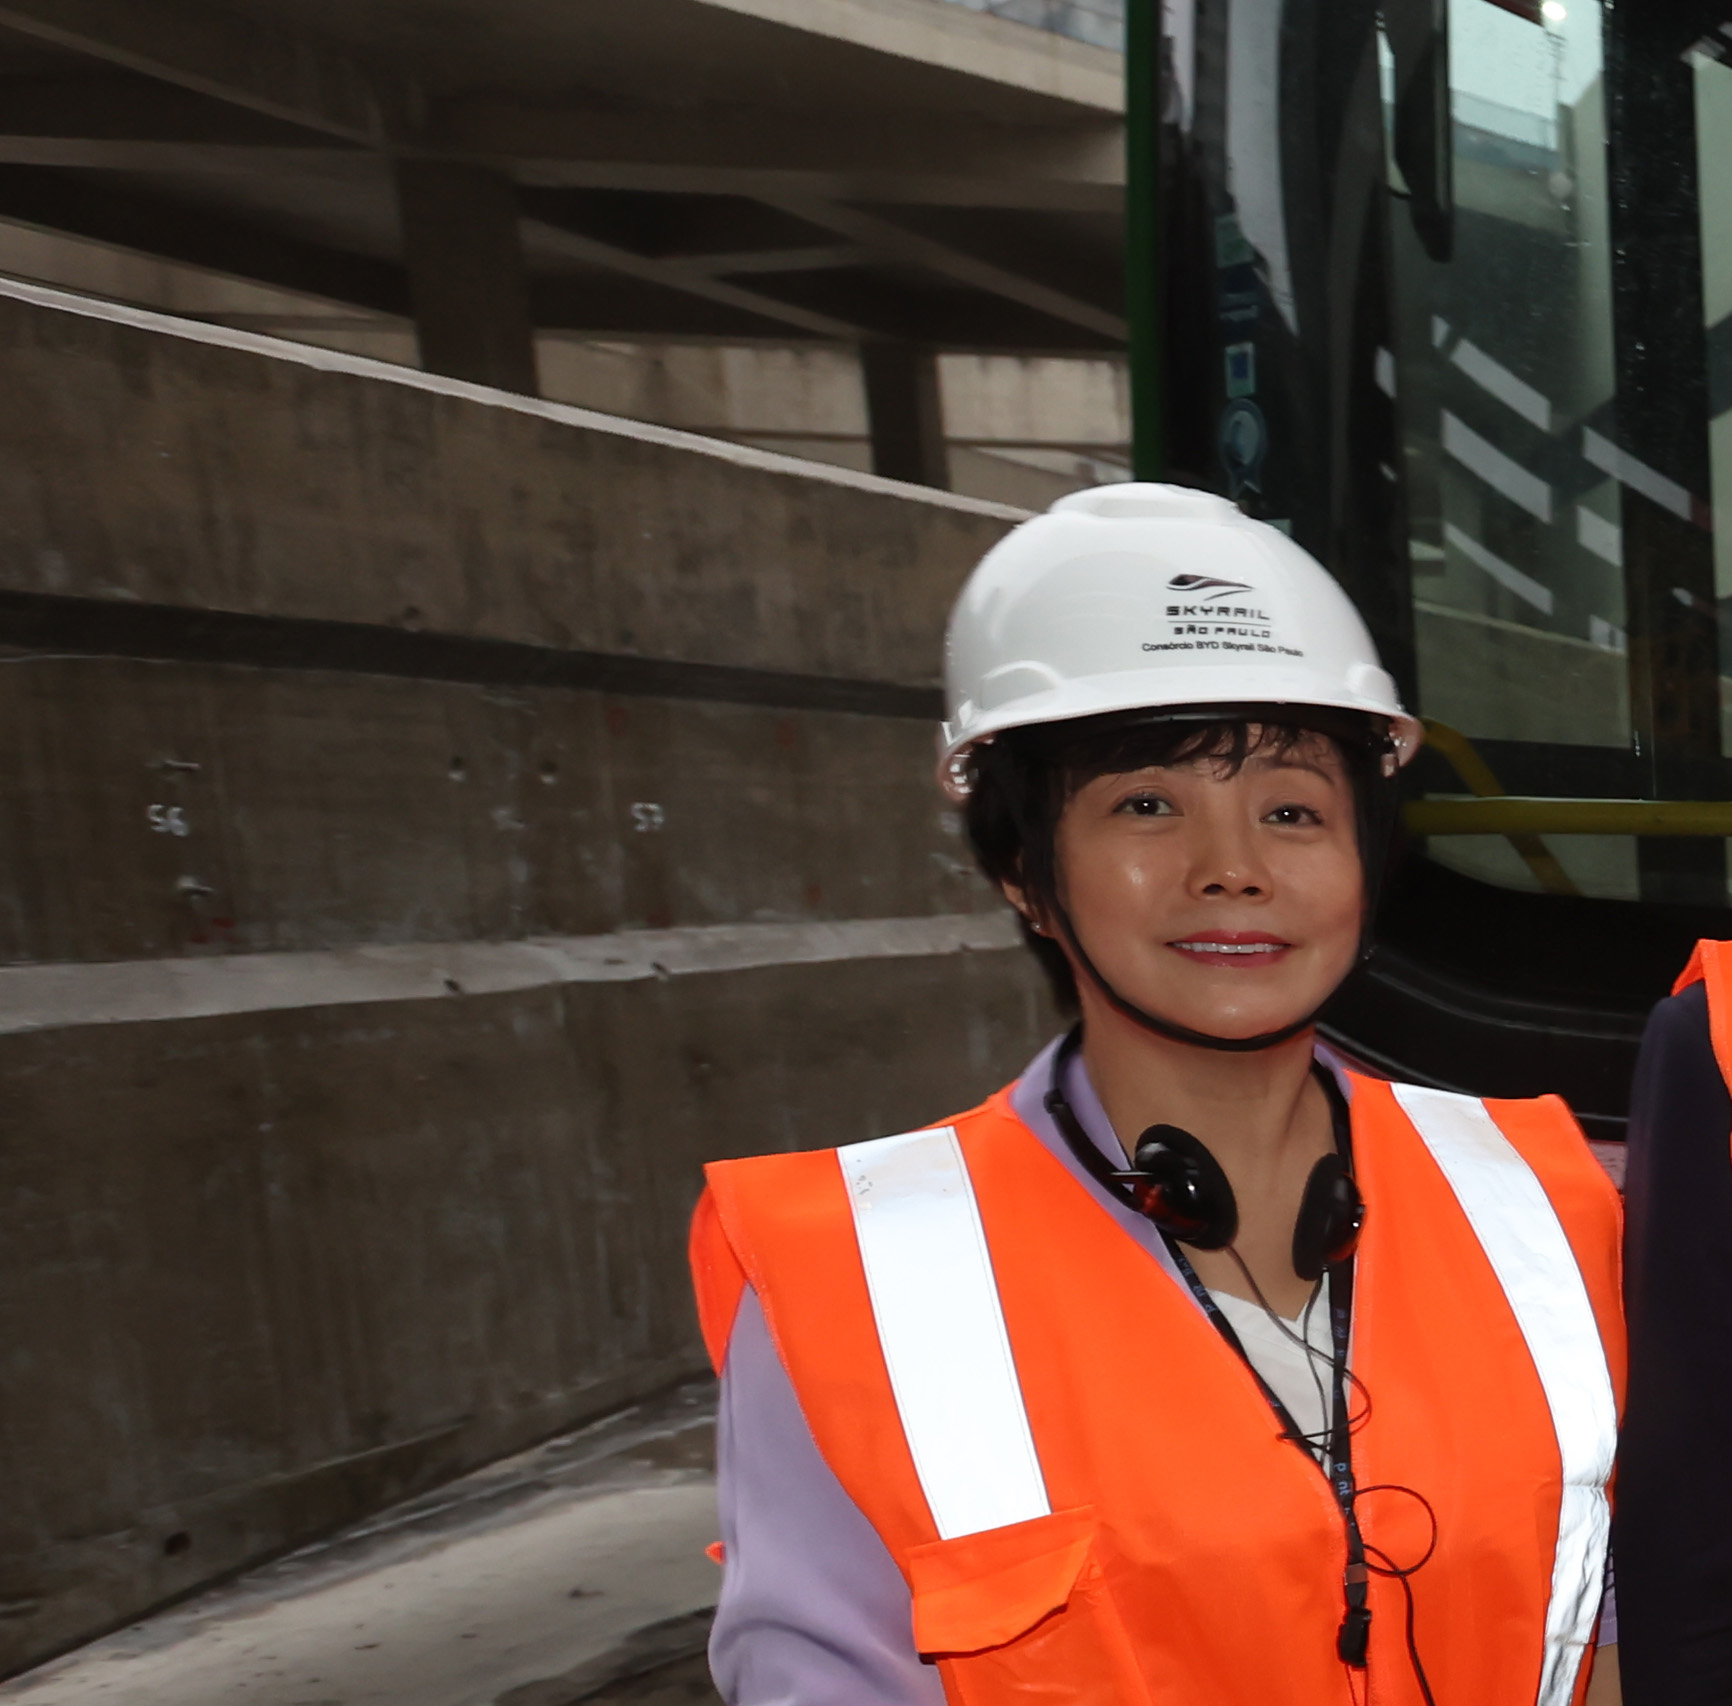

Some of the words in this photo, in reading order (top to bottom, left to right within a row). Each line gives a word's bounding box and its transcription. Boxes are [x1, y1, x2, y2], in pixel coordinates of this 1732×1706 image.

[1166, 605, 1270, 620] SKYRAIL
[1174, 624, 1208, 635] SÃO
[1214, 626, 1271, 638] PAULO
[1142, 641, 1194, 652] Consórcio
[1196, 641, 1220, 650] BYD
[1257, 643, 1276, 654] São
